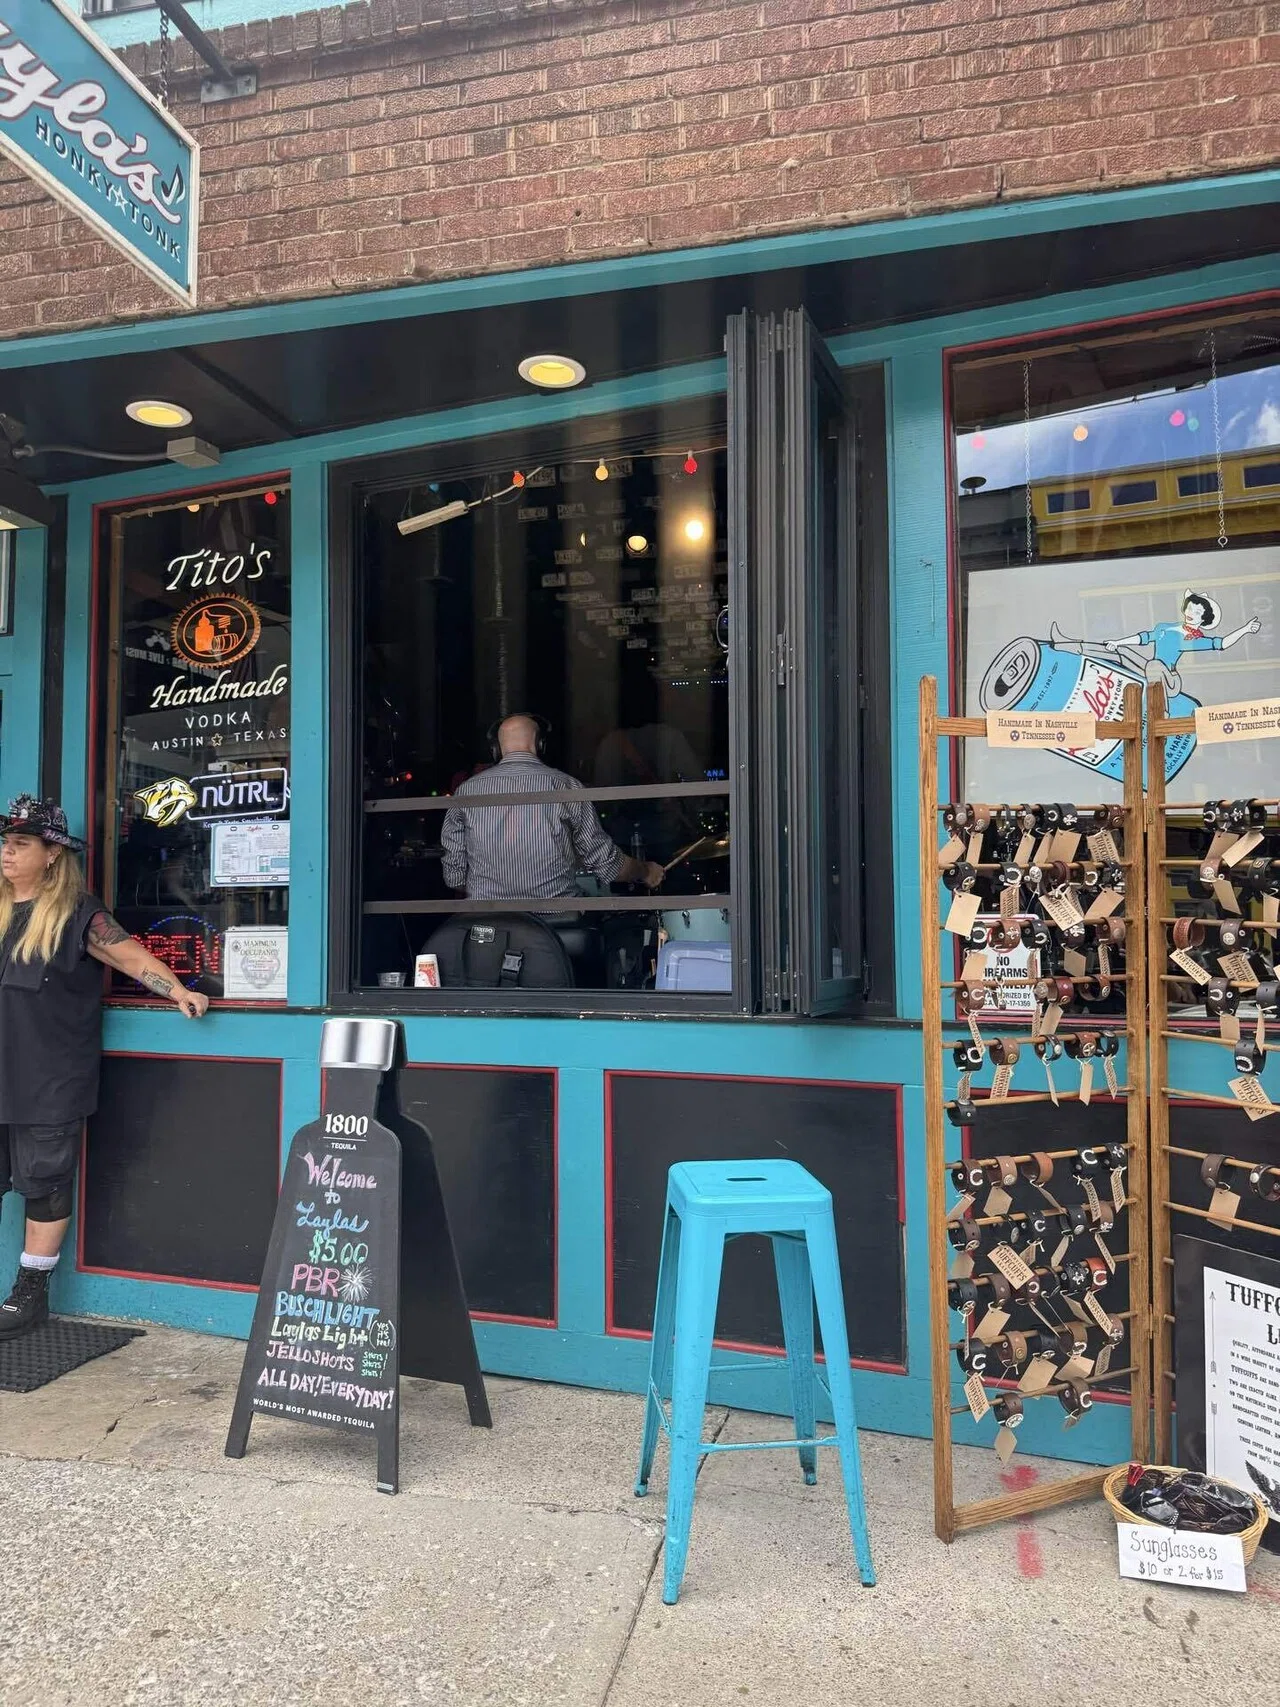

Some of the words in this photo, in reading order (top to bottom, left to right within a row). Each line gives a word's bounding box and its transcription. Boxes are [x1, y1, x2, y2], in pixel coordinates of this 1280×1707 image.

[0, 21, 181, 224] yla's
[35, 115, 113, 202] HONKY
[129, 200, 181, 263] TONK
[165, 542, 271, 591] Tito's
[150, 664, 288, 709] Handmade
[185, 711, 251, 729] VODKA
[1104, 702, 1118, 721] ONKY
[1208, 710, 1248, 722] HANDMADE
[998, 718, 1032, 728] HANDMADE
[1045, 719, 1078, 729] NASHVILLE
[1235, 720, 1276, 731] TENNESSEE
[151, 736, 204, 751] AUSTIN
[233, 727, 287, 742] TEXAS
[1021, 731, 1056, 740] TENNESSEE
[1169, 733, 1184, 752] HAR
[243, 939, 277, 948] MAXIMUM
[996, 956, 1010, 966] NO
[983, 967, 1028, 978] IREARMS
[325, 1112, 369, 1136] 1800
[331, 1142, 357, 1151] TEQUILA
[302, 1151, 378, 1189] Welcome
[324, 1189, 341, 1205] to
[296, 1201, 370, 1240] Laylas
[308, 1229, 369, 1266] $5.00
[995, 1247, 1028, 1282] TUFFCUFFS
[290, 1263, 341, 1298] PBR
[271, 1316, 321, 1345] Laylas
[322, 1324, 369, 1350] Light
[257, 1366, 287, 1388] ALL
[1230, 1364, 1258, 1380] TUFFCUFFS
[253, 1398, 284, 1410] WORLD'S
[285, 1404, 306, 1415] MOST
[306, 1409, 342, 1422] AWARDED
[343, 1416, 375, 1429] TEQUILA
[1130, 1530, 1218, 1563] Sunglasses
[1138, 1561, 1158, 1577] $10
[1163, 1567, 1174, 1577] or
[1178, 1565, 1187, 1577] 2
[1189, 1567, 1204, 1580] for
[1205, 1567, 1224, 1580] $15
